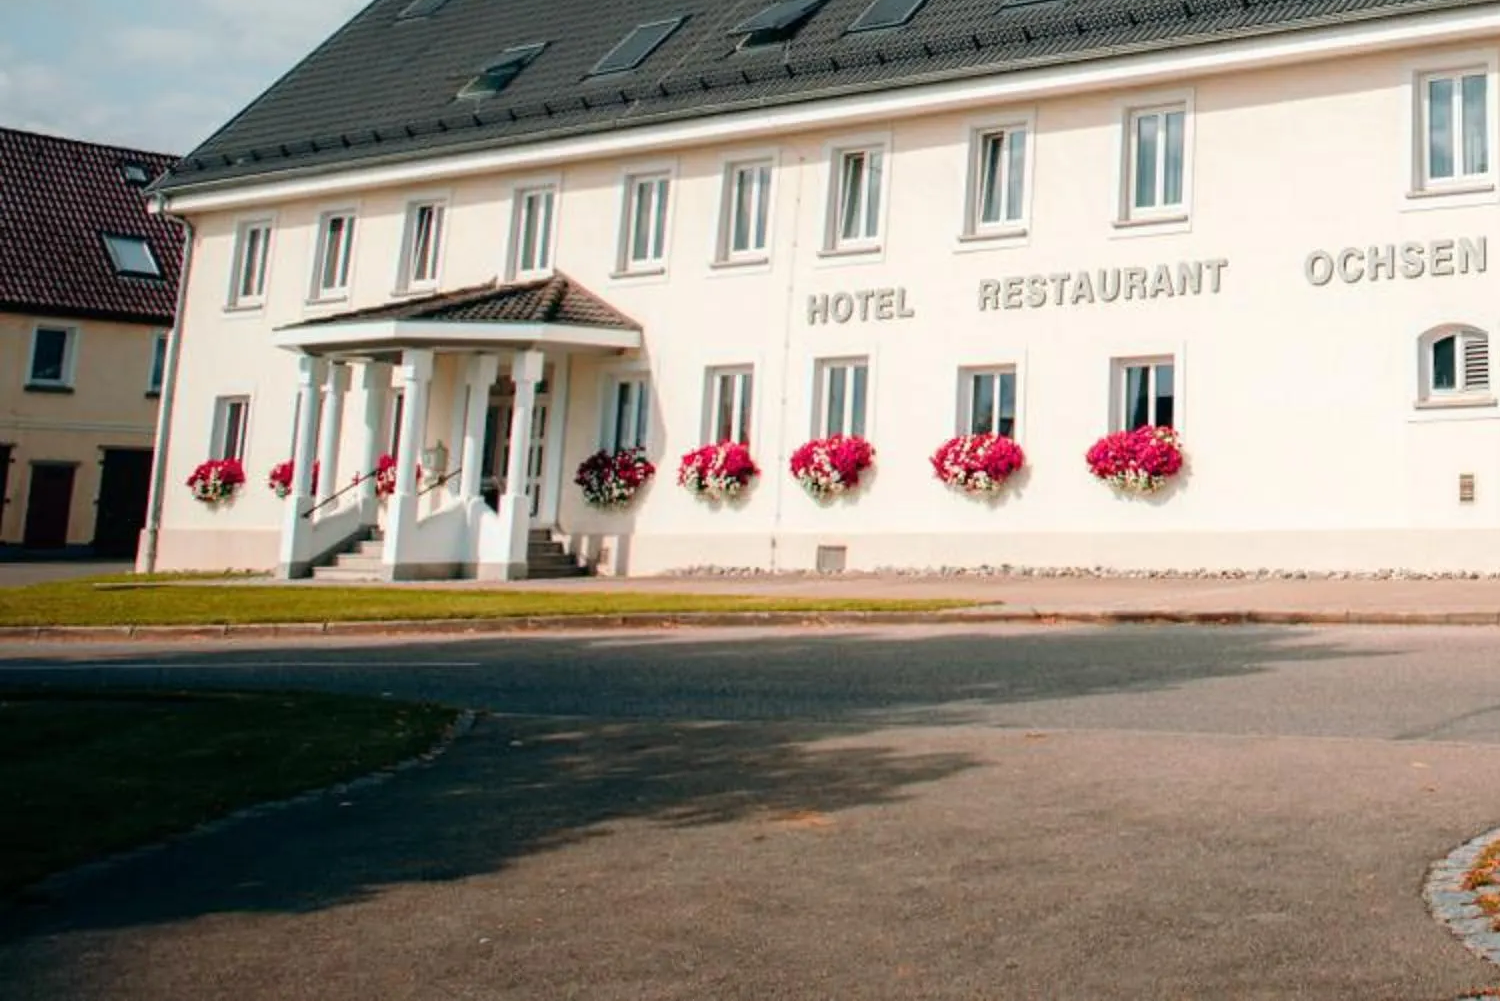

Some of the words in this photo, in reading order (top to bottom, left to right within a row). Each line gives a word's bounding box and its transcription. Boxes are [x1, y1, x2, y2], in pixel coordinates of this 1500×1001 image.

[807, 288, 915, 326] HOTEL
[979, 259, 1229, 311] RESTAURANT
[1306, 236, 1487, 286] OCHSEN
